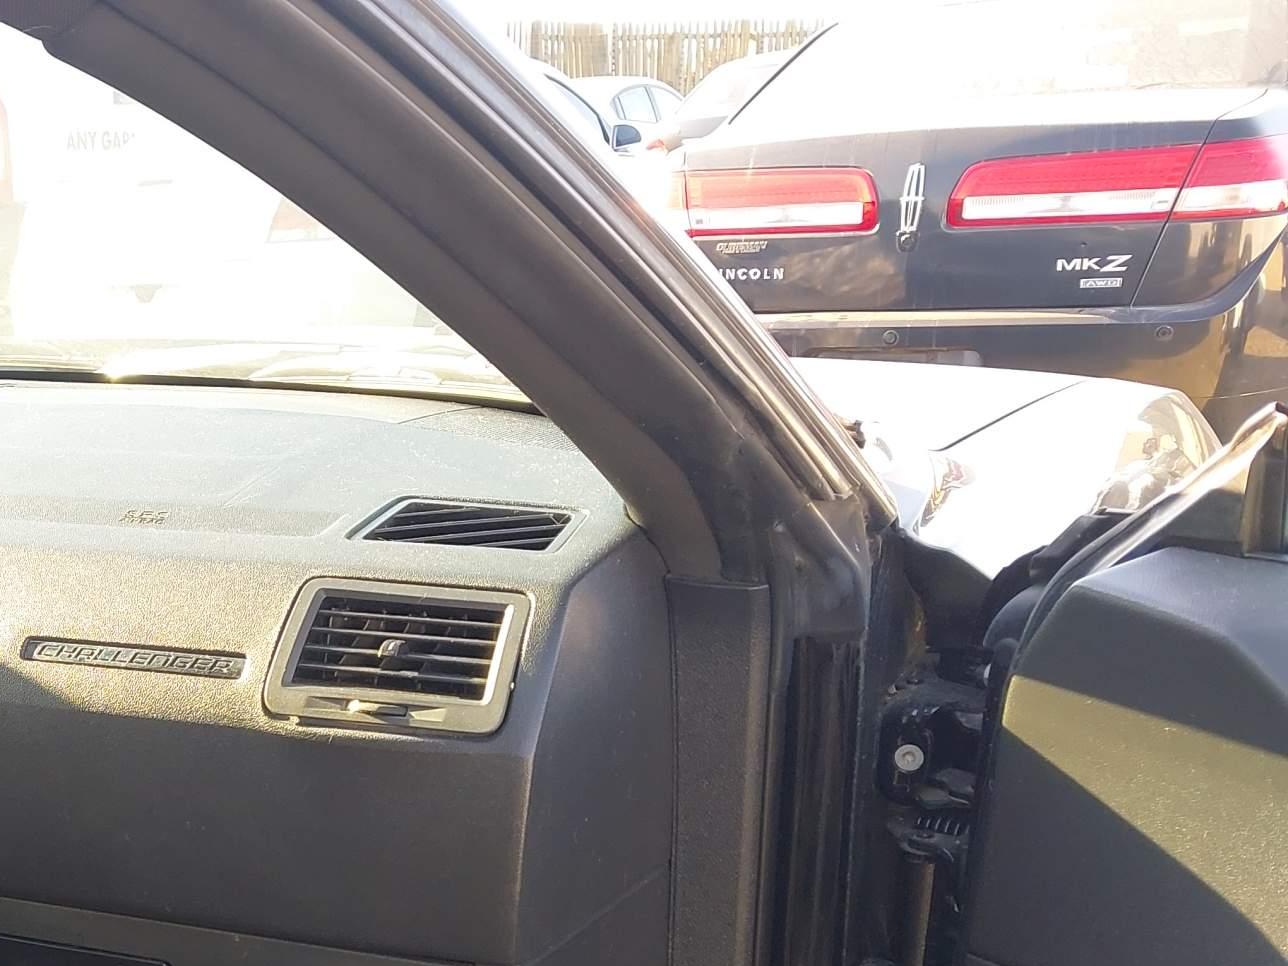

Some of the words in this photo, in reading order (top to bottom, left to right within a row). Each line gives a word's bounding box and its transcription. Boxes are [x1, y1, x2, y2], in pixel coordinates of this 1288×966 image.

[66, 130, 97, 151] ANY
[1055, 254, 1133, 272] MKZ
[718, 267, 785, 281] INCOLN
[1083, 279, 1120, 287] AWD
[36, 643, 233, 676] CHALLENGER
